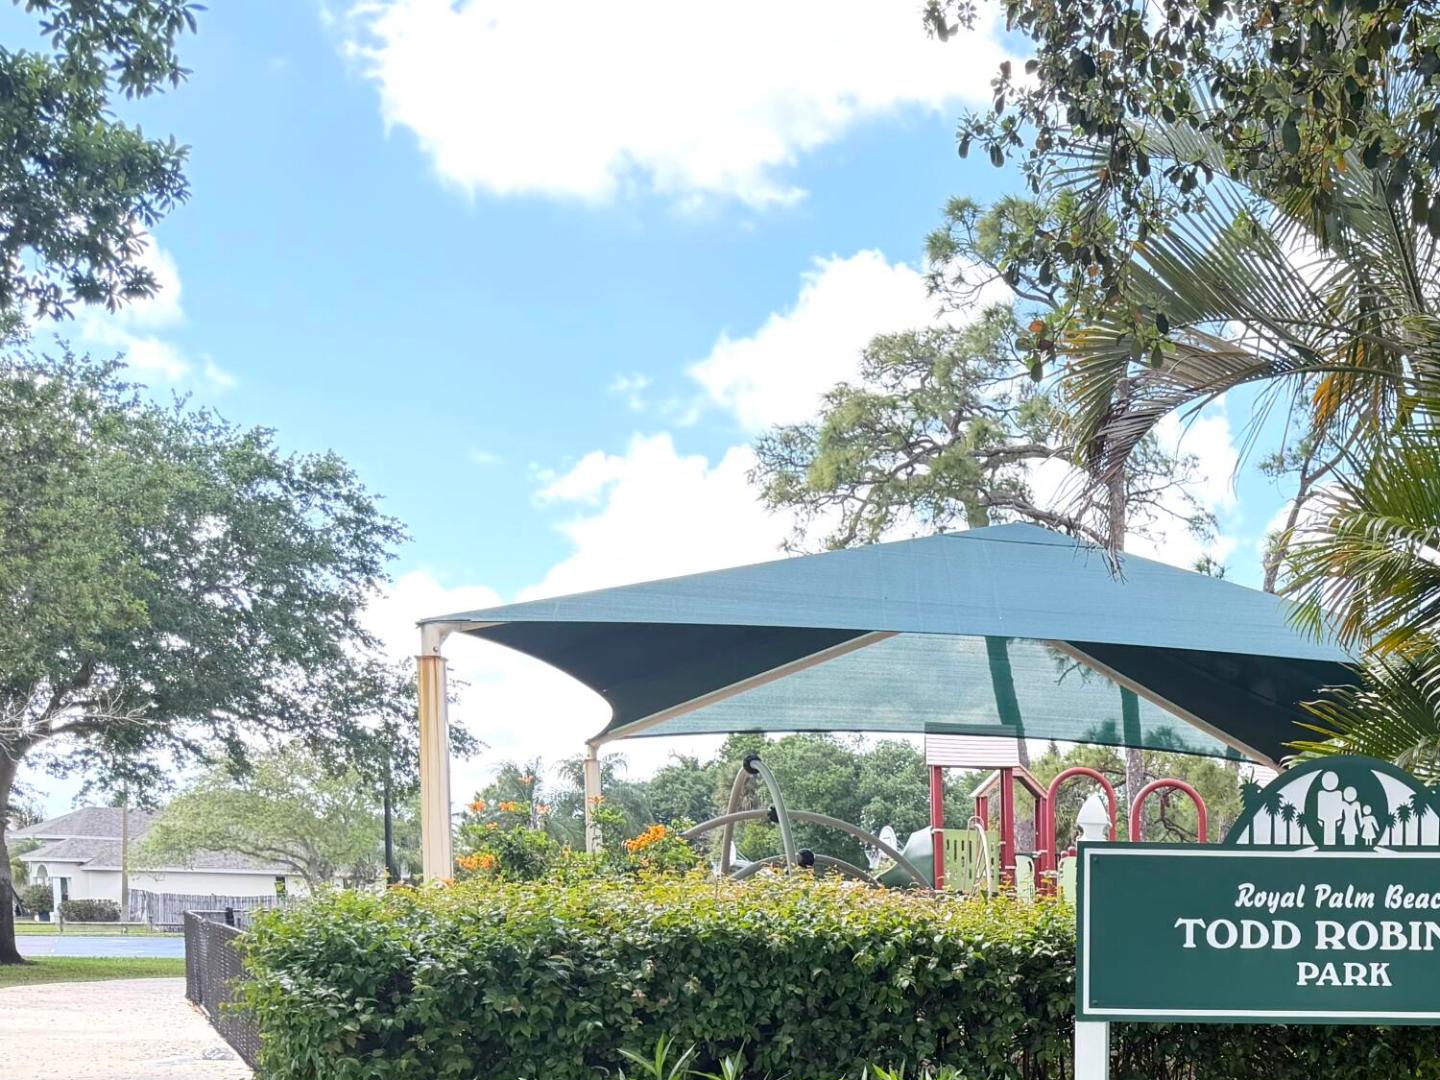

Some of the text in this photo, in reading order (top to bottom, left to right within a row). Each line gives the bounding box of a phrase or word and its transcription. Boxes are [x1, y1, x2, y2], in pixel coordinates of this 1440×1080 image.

[1234, 882, 1306, 914] Royal
[1314, 883, 1375, 909] Palm
[1174, 917, 1302, 950] TODD
[1296, 961, 1393, 987] PARK
